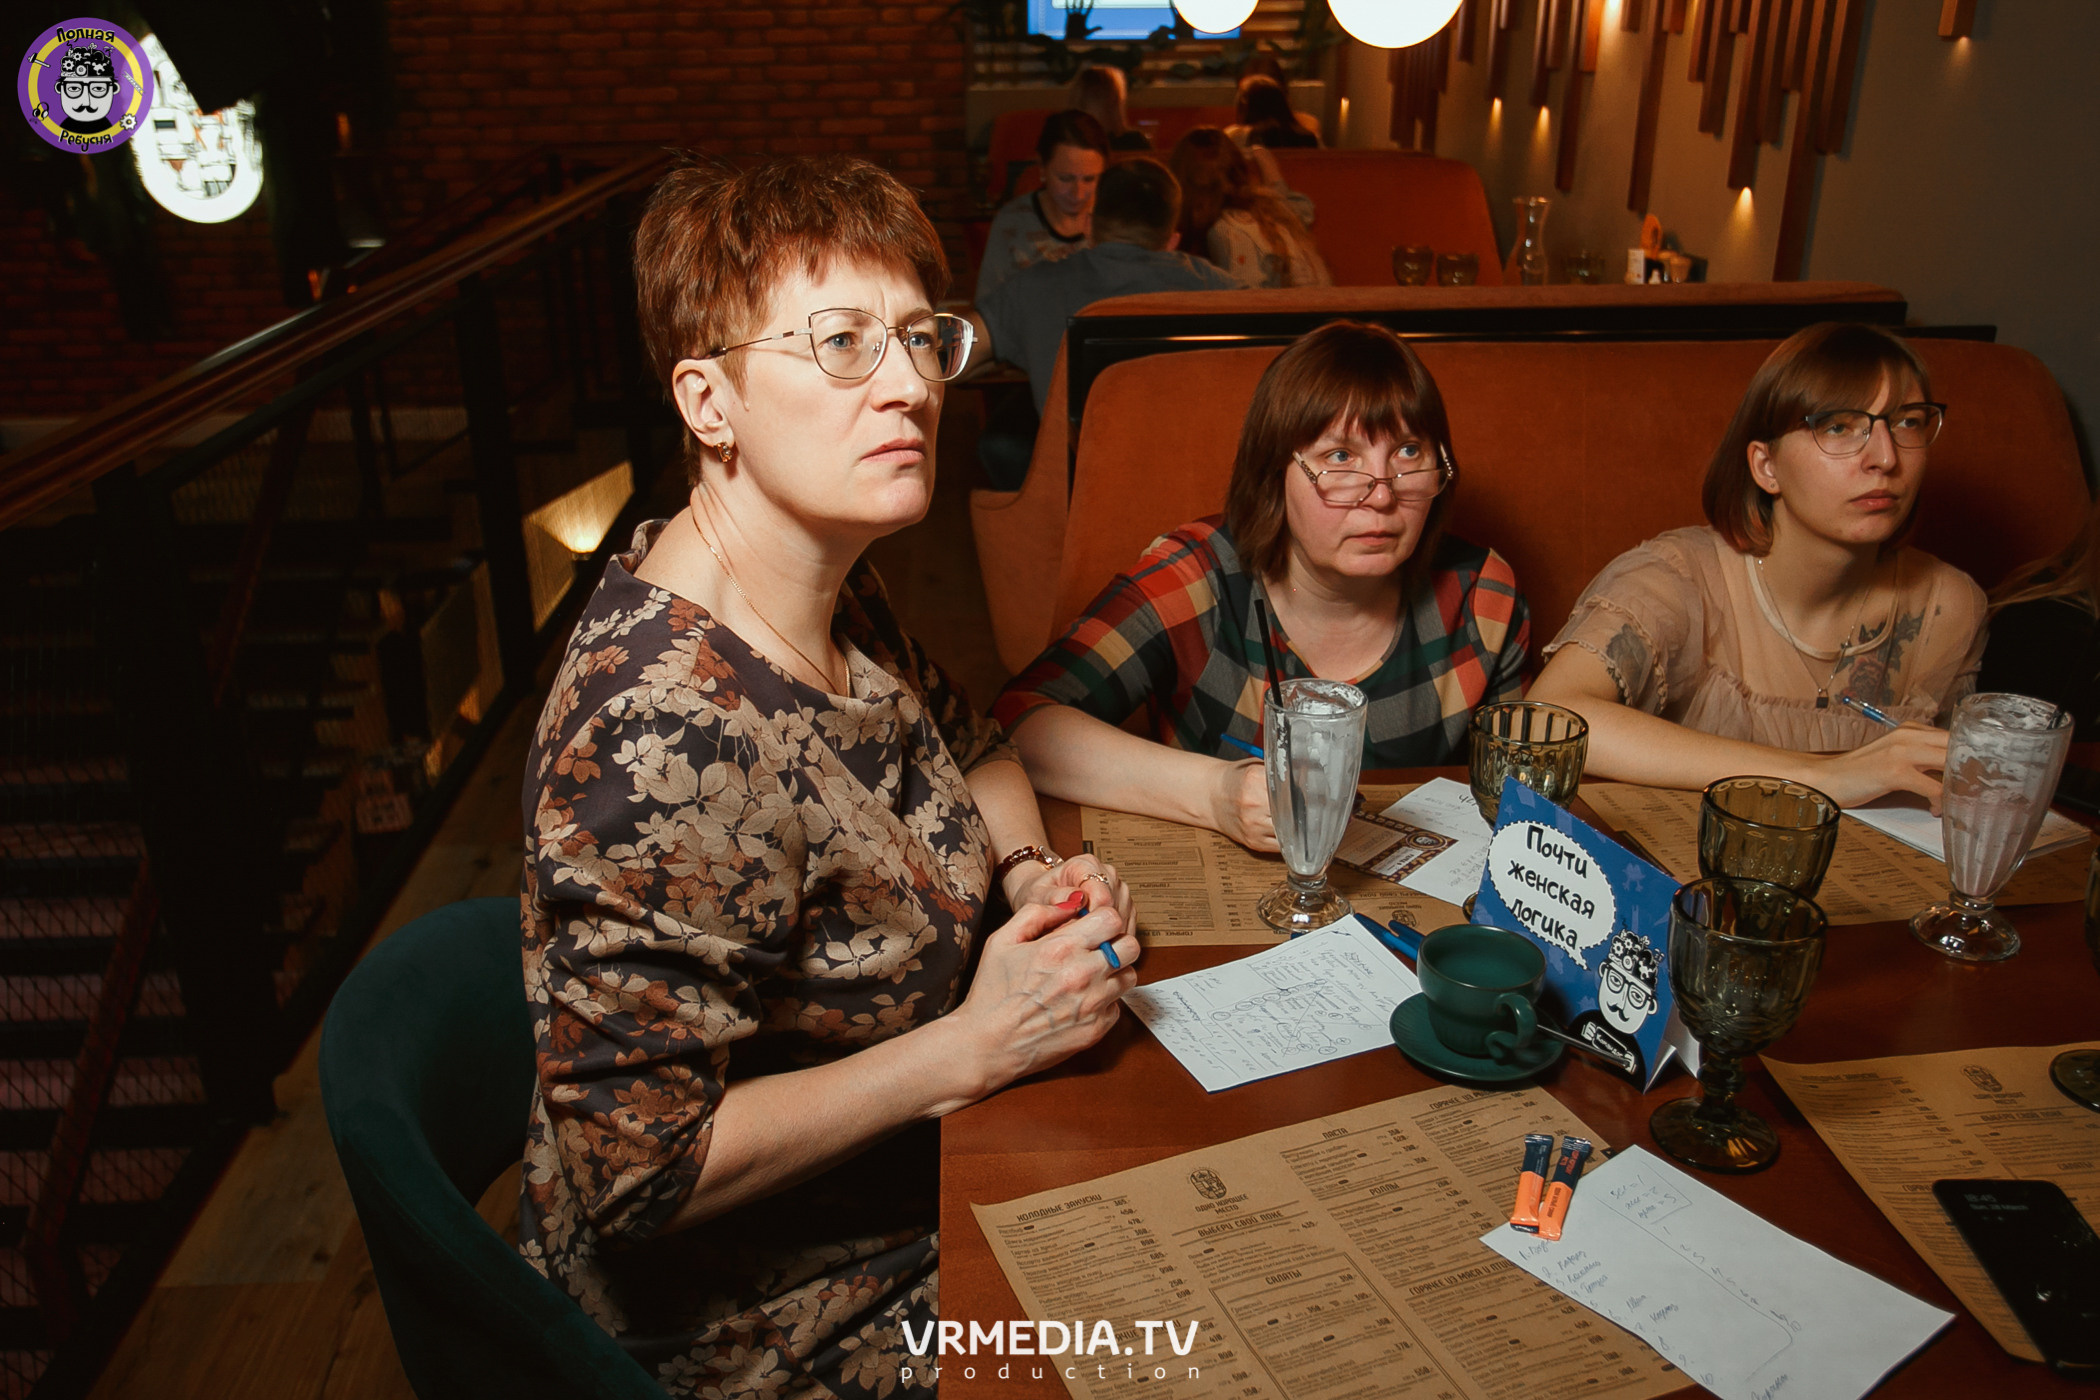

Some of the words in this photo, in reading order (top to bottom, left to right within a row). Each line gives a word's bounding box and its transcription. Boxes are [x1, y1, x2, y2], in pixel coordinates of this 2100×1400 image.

[1526, 824, 1588, 879] Почти
[1507, 859, 1595, 920] женская
[1322, 1127, 1349, 1140] ПАСТА
[1369, 1182, 1400, 1196] РОЛЛЫ
[1016, 1203, 1064, 1222] ХОЛОДНЫЕ
[1064, 1194, 1102, 1210] ЗАКУСКИ
[1215, 1204, 1239, 1215] МЕСТО
[1197, 1222, 1233, 1238] ВЫБЕРИ
[1235, 1216, 1258, 1230] СВОЙ
[1260, 1210, 1284, 1222] ПОКЕ
[1265, 1269, 1302, 1285] САЛАТЫ
[1408, 1280, 1445, 1296] ГОРЯЧЕЕ
[1445, 1275, 1459, 1286] ИЗ
[1457, 1267, 1483, 1281] МЯСА
